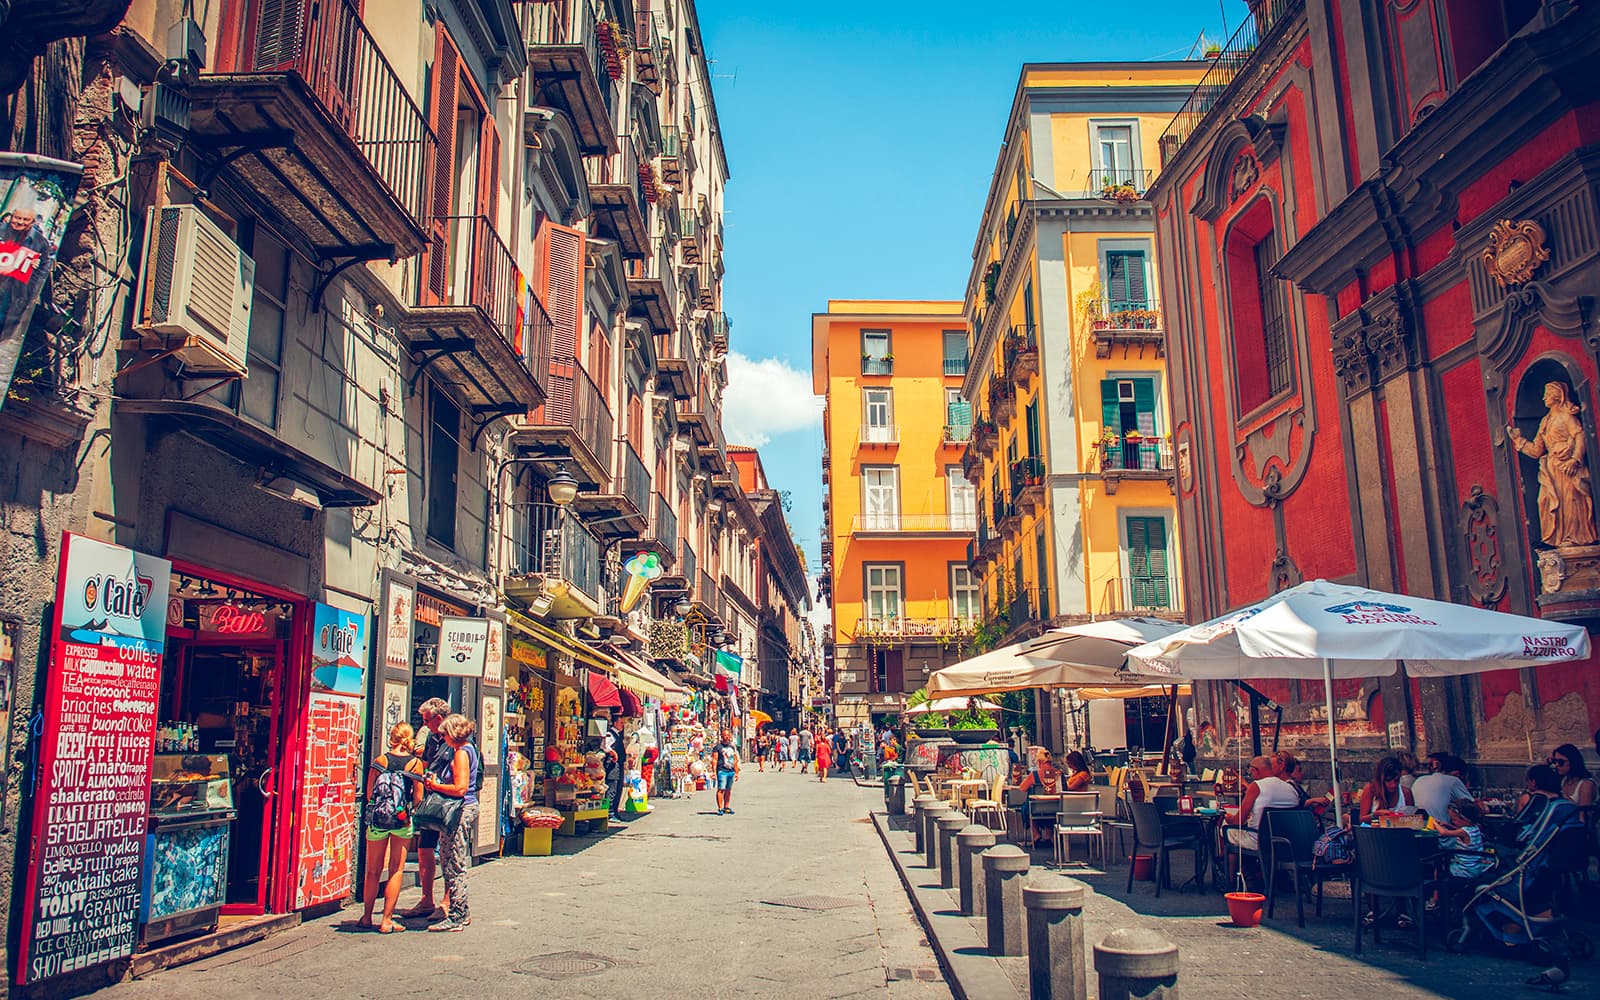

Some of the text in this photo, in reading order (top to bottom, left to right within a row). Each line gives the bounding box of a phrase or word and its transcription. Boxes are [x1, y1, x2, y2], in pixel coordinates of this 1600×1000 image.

[211, 605, 267, 633] Bar
[119, 641, 158, 664] coffee
[1522, 636, 1568, 647] NASTRO
[1522, 645, 1577, 657] AZZURRO
[61, 671, 84, 687] TEA
[126, 662, 156, 679] water
[84, 685, 131, 699] croissant
[132, 689, 154, 699] MILK
[61, 695, 112, 715] brioches
[127, 713, 153, 733] coke
[57, 731, 150, 759] BEER fruit juices
[87, 748, 149, 763] APERITIF
[51, 760, 87, 789] SPRITZ
[88, 761, 127, 775] amaro
[87, 774, 146, 789] ALMOND MILK
[50, 787, 115, 805] shakerato
[48, 801, 146, 824] DRAFT BEER ginseng
[47, 817, 145, 845] SFOGLIATELLE
[45, 837, 140, 859] LIMONCELLO vodka
[43, 853, 139, 875] baileys rum grappa
[40, 862, 138, 898] TEA cocktails cake
[40, 891, 88, 919] TOAST
[83, 893, 141, 920] GRANITE
[35, 921, 51, 940] RED
[72, 917, 102, 933] LONG
[35, 922, 133, 956] ICE CREAM cookies
[65, 931, 135, 958] WHITE WINE
[31, 952, 65, 981] SHOT
